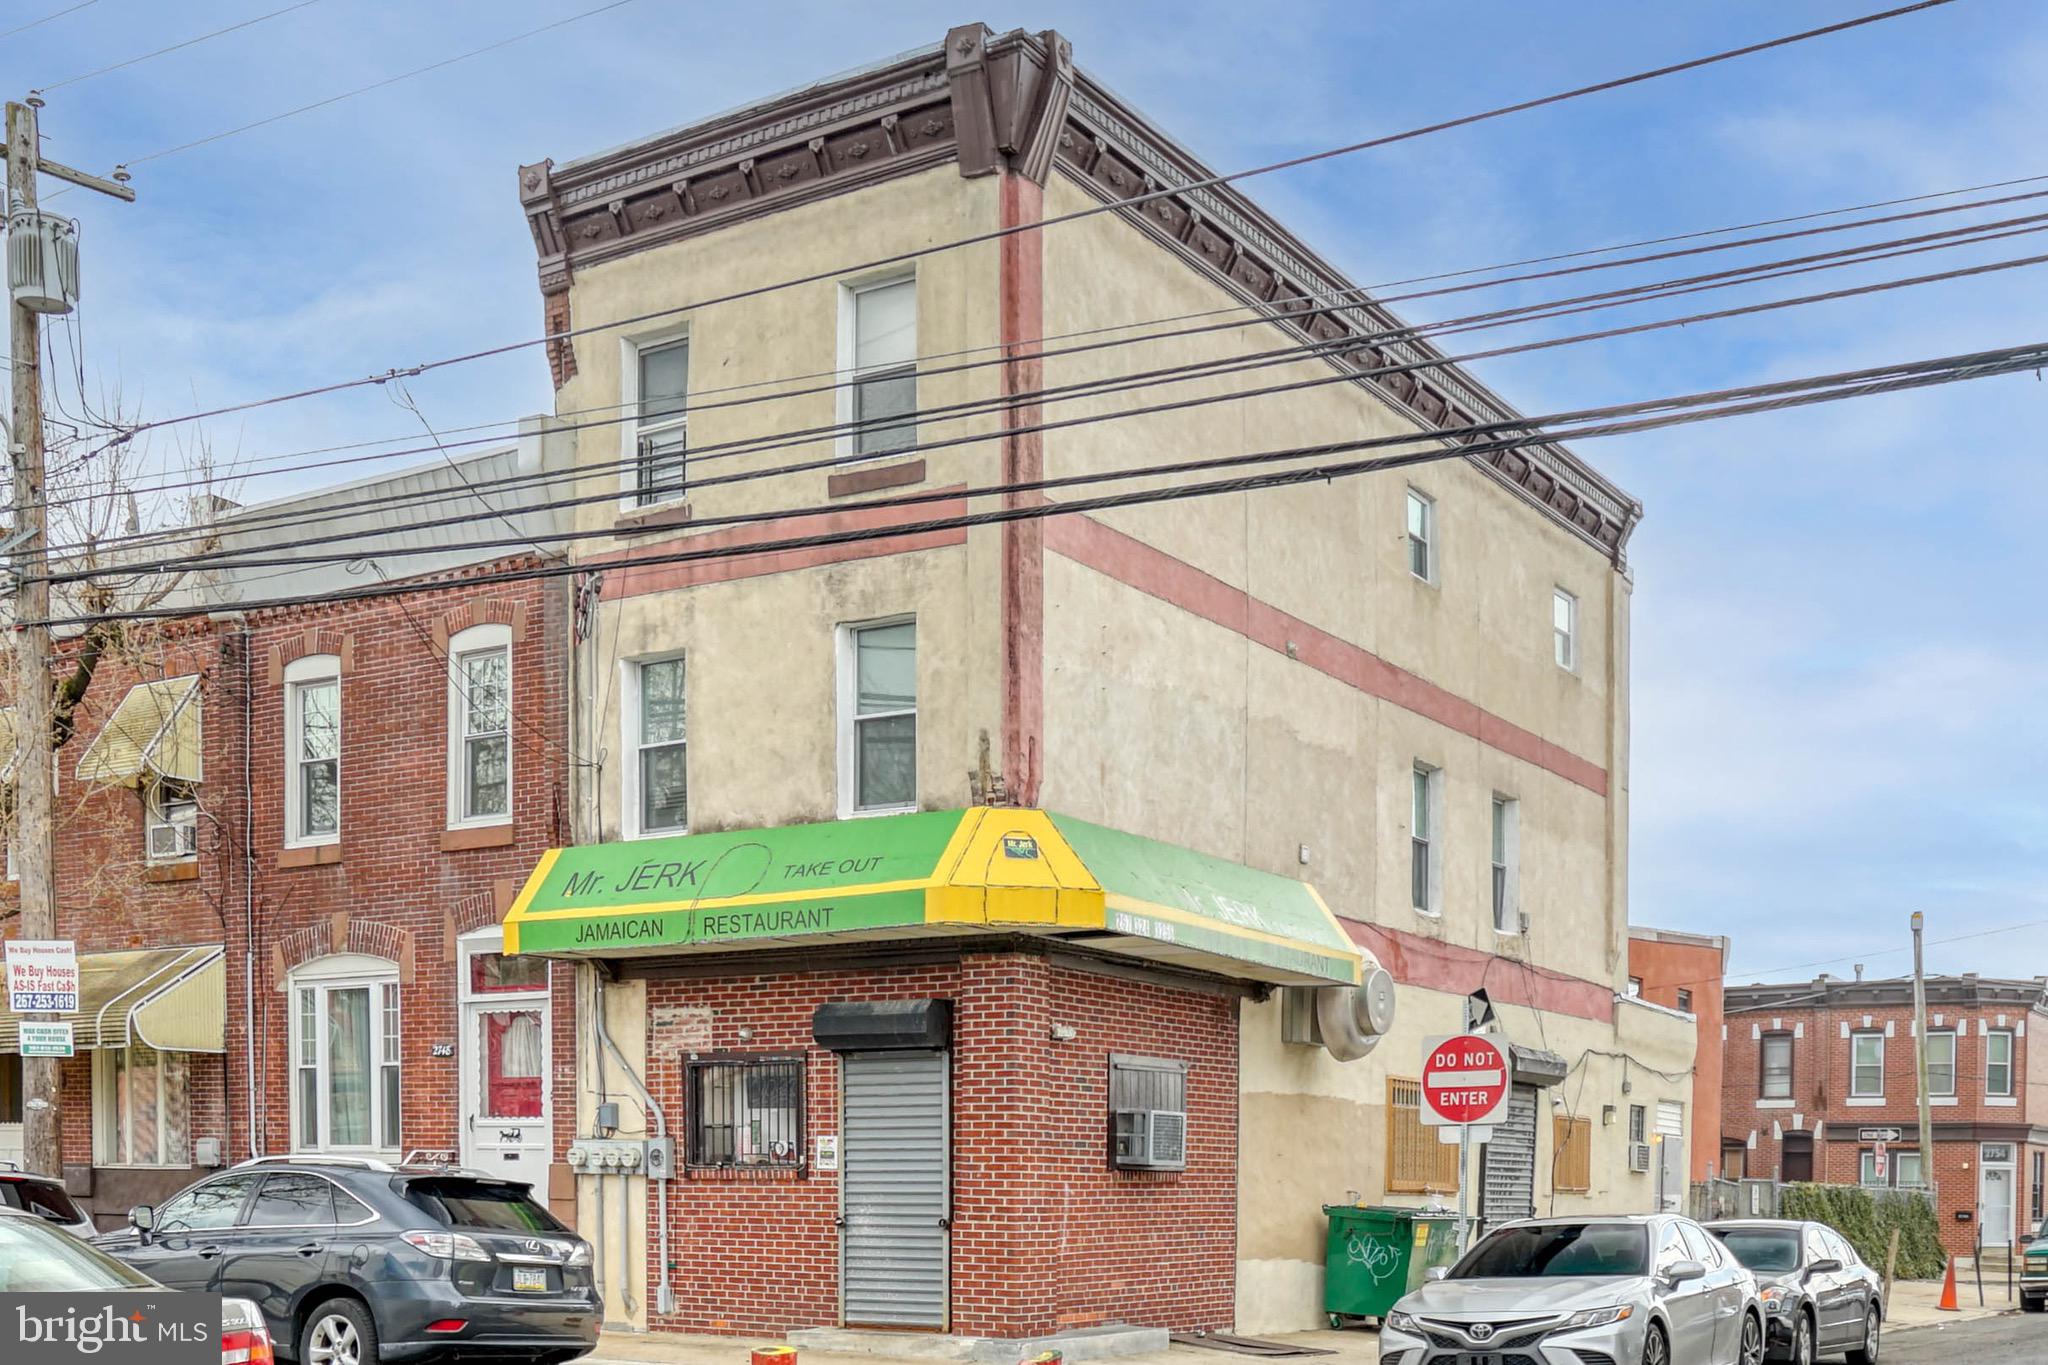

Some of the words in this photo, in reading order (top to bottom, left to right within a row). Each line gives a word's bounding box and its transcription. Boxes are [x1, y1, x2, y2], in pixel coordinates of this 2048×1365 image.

[784, 860, 835, 879] TAKE
[838, 856, 885, 874] OUT
[561, 870, 605, 897] Mr.
[575, 918, 664, 943] JAMAICAN
[703, 906, 835, 936] RESTAURANT
[13, 965, 26, 977] We
[28, 965, 44, 979] Buy
[46, 965, 76, 978] Houses
[13, 980, 36, 992] AS-IS
[38, 980, 55, 992] Fast
[1435, 1053, 1457, 1068] DO
[1463, 1052, 1495, 1067] NOT
[1440, 1091, 1488, 1106] ENTER
